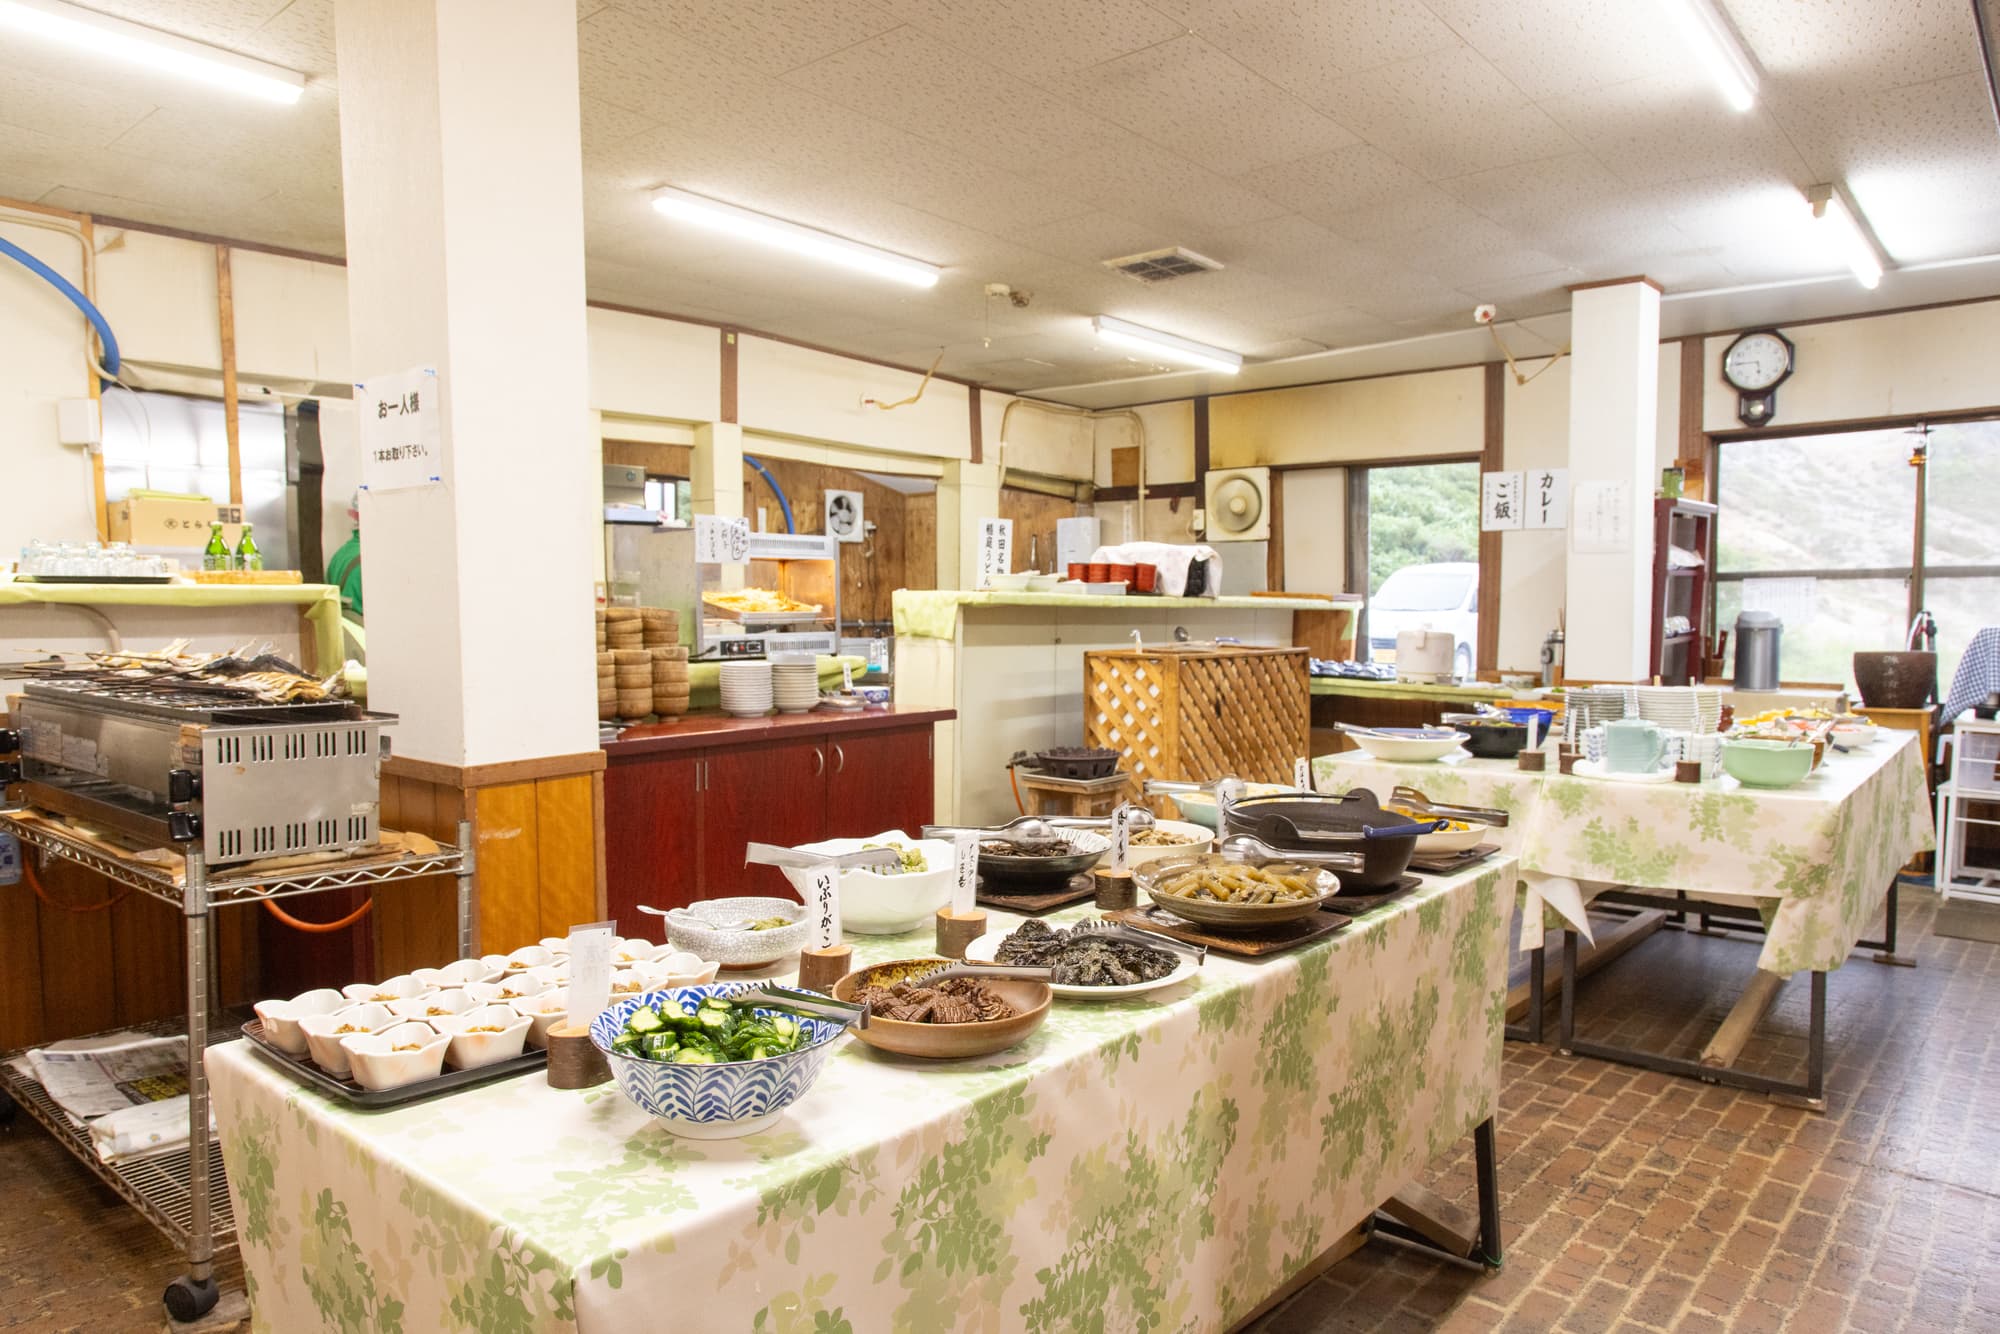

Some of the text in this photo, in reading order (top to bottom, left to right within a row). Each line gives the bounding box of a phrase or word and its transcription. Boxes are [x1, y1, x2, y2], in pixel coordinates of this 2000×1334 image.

[377, 391, 420, 420] お一人様
[1494, 481, 1511, 519] ご飯
[1540, 472, 1553, 524] カレー
